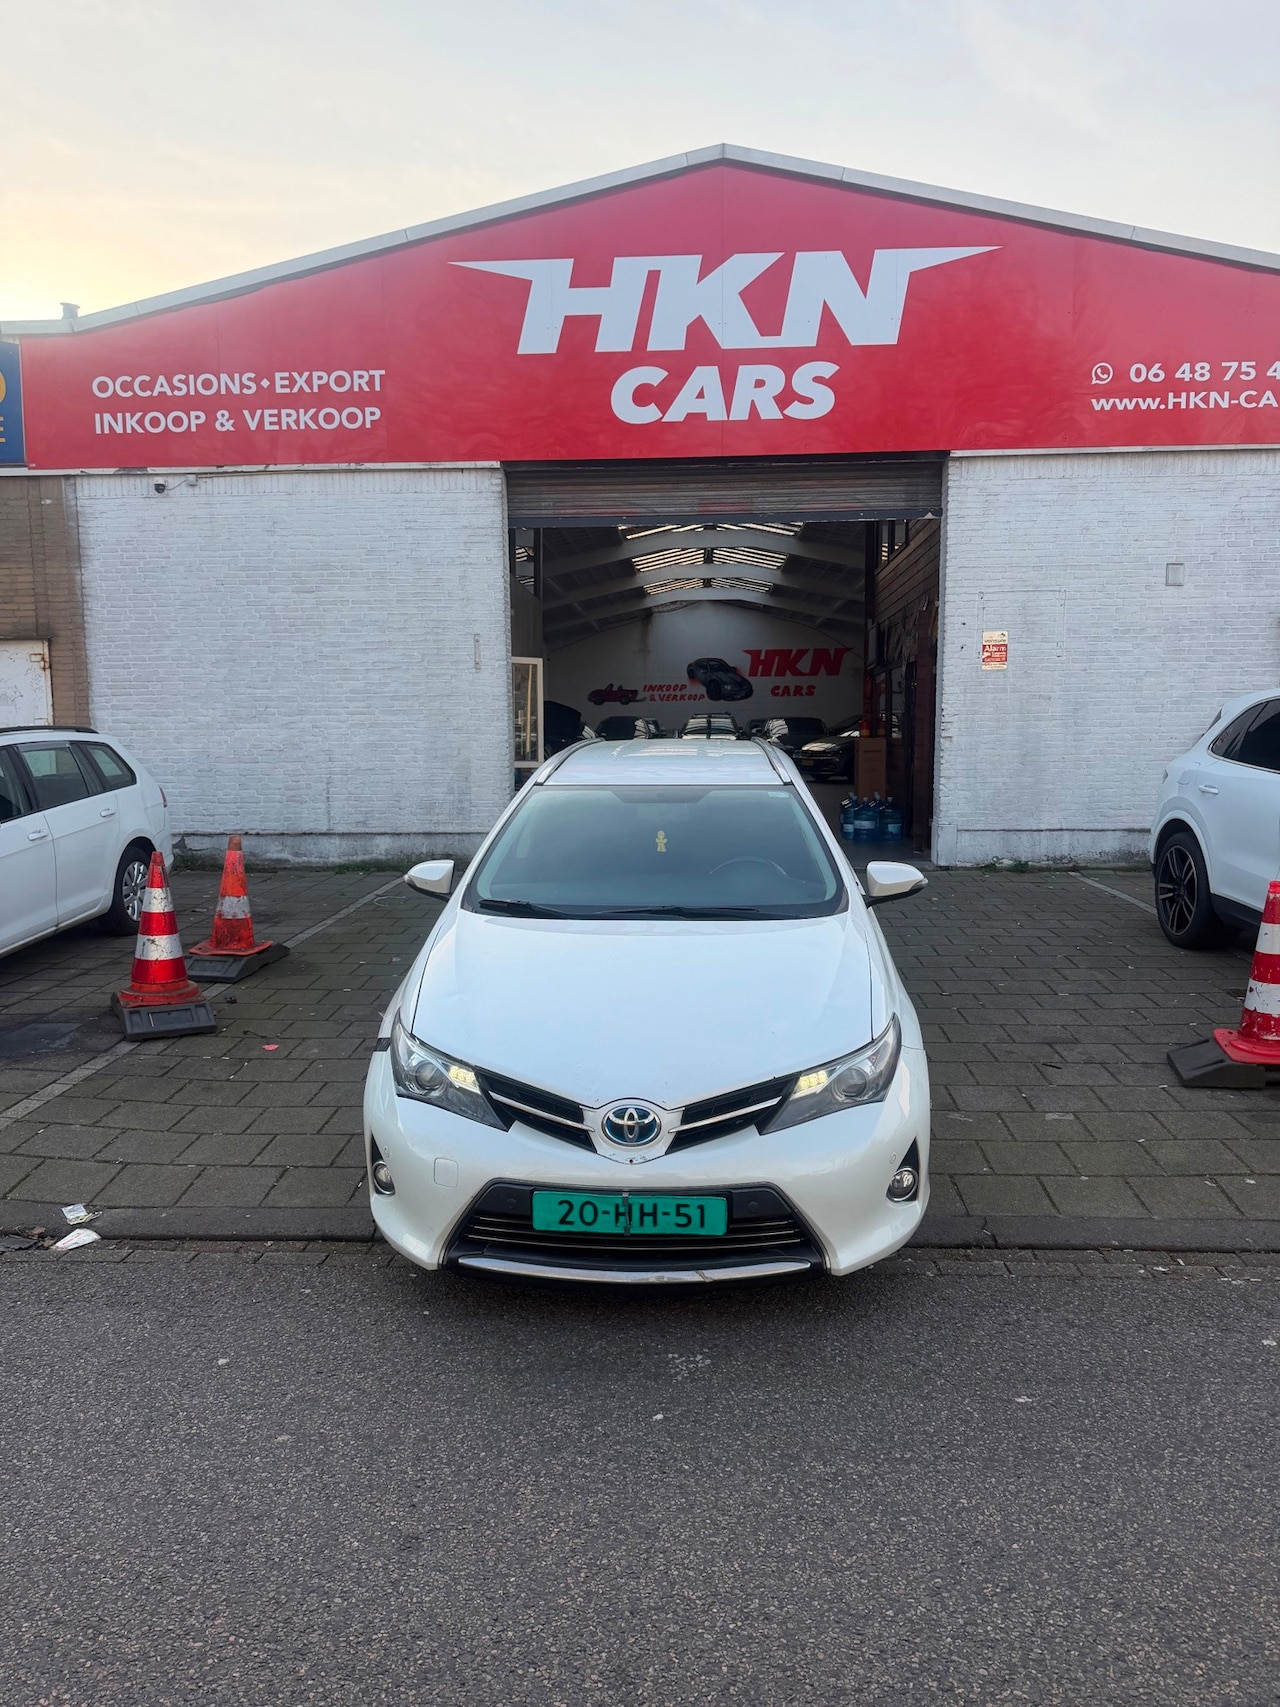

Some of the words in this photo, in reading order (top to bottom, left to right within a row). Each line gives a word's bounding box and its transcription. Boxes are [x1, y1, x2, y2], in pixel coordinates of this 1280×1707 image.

[447, 246, 1002, 355] HKN
[1129, 363, 1166, 383] 06
[1174, 362, 1211, 382] 48
[1221, 361, 1257, 381] 75
[610, 361, 839, 425] CARS
[94, 410, 206, 434] INKOOP
[214, 409, 235, 432] &
[243, 406, 382, 431] VERKOOP
[743, 648, 853, 677] HKN
[642, 684, 688, 693] INKOOP
[659, 693, 705, 702] VERKOOP
[770, 684, 816, 697] CARS
[557, 1199, 706, 1229] 20-HH-51
